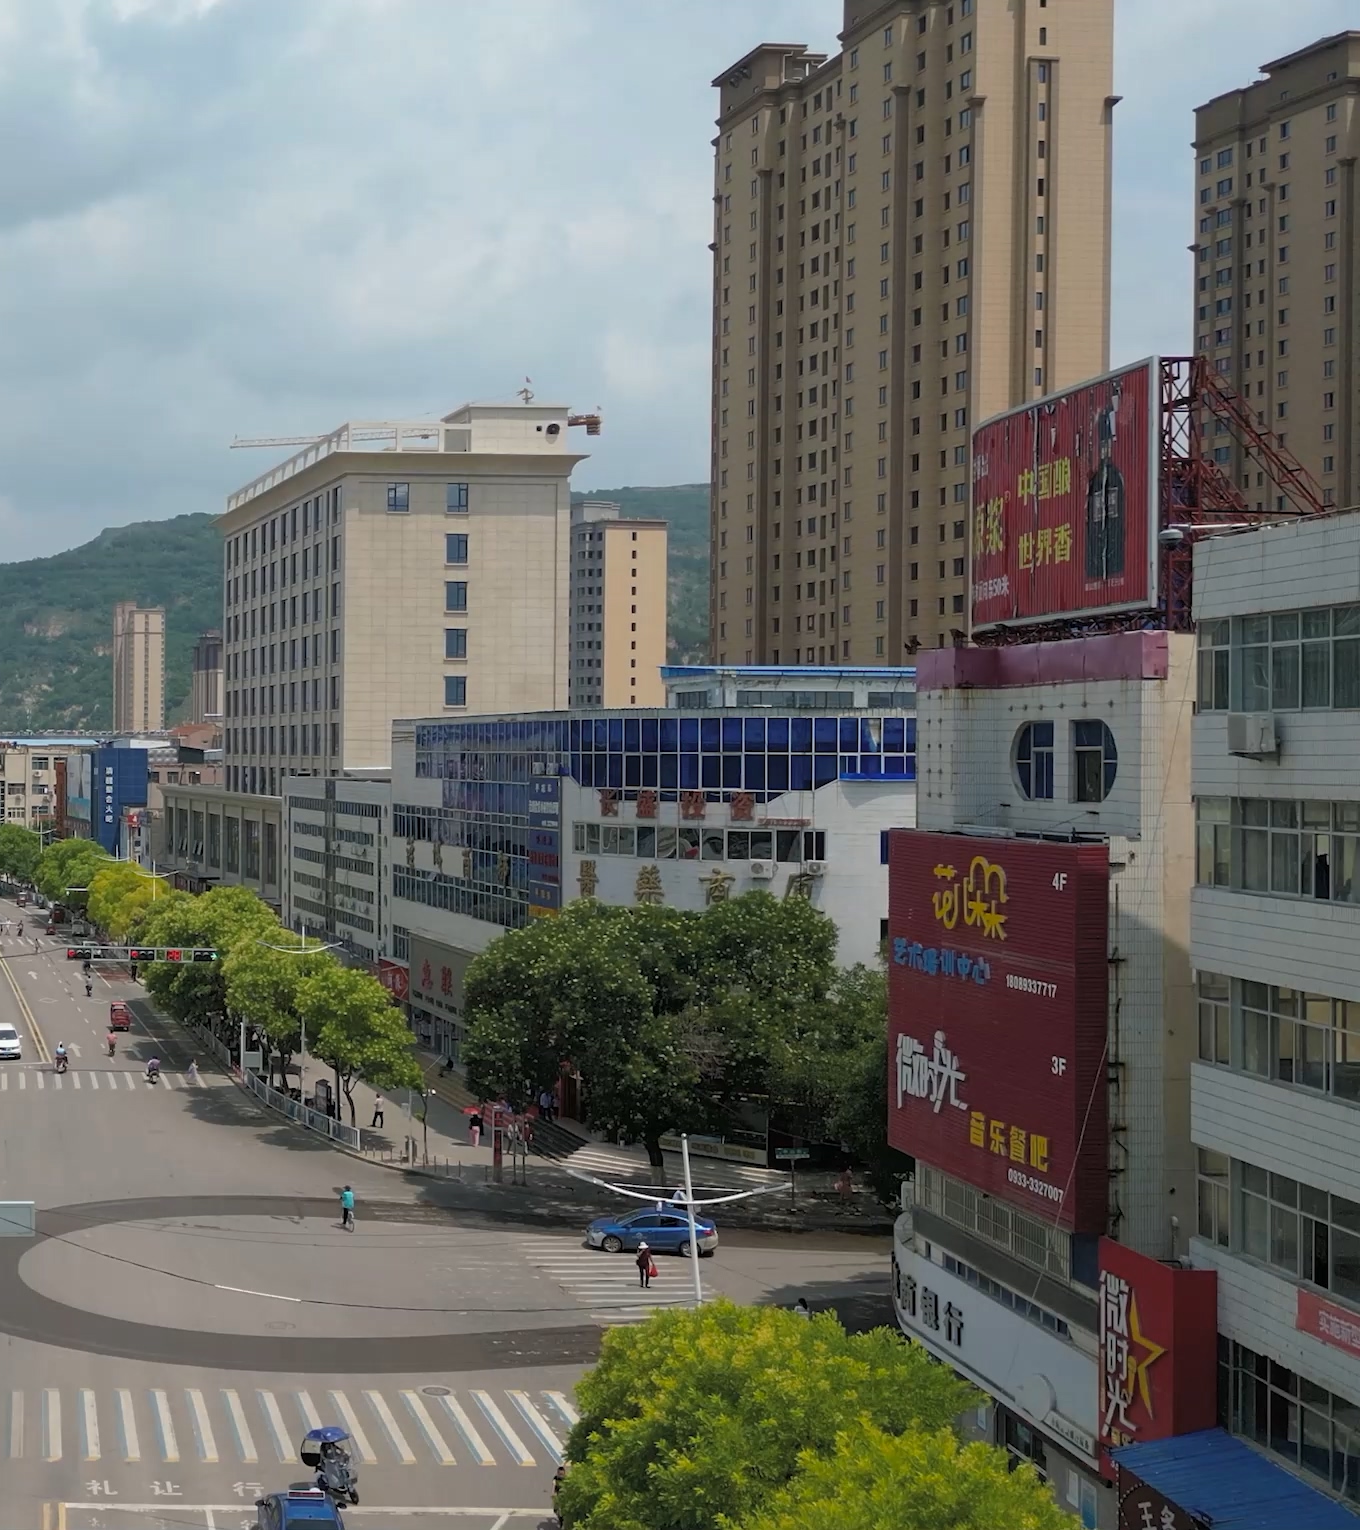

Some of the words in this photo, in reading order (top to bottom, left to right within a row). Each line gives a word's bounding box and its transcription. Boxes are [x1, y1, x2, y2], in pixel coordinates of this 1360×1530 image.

[1018, 522, 1072, 570] 世界香
[1051, 872, 1068, 892] 4F
[893, 936, 991, 985] 艺术培训中心
[1005, 973, 1058, 998] 18089337717
[896, 1030, 968, 1113] 微时光
[1050, 1056, 1067, 1076] 3F
[969, 1111, 1050, 1173] 音乐餐吧
[1007, 1167, 1064, 1204] 0933-3327007
[1099, 1269, 1137, 1437] 微时光
